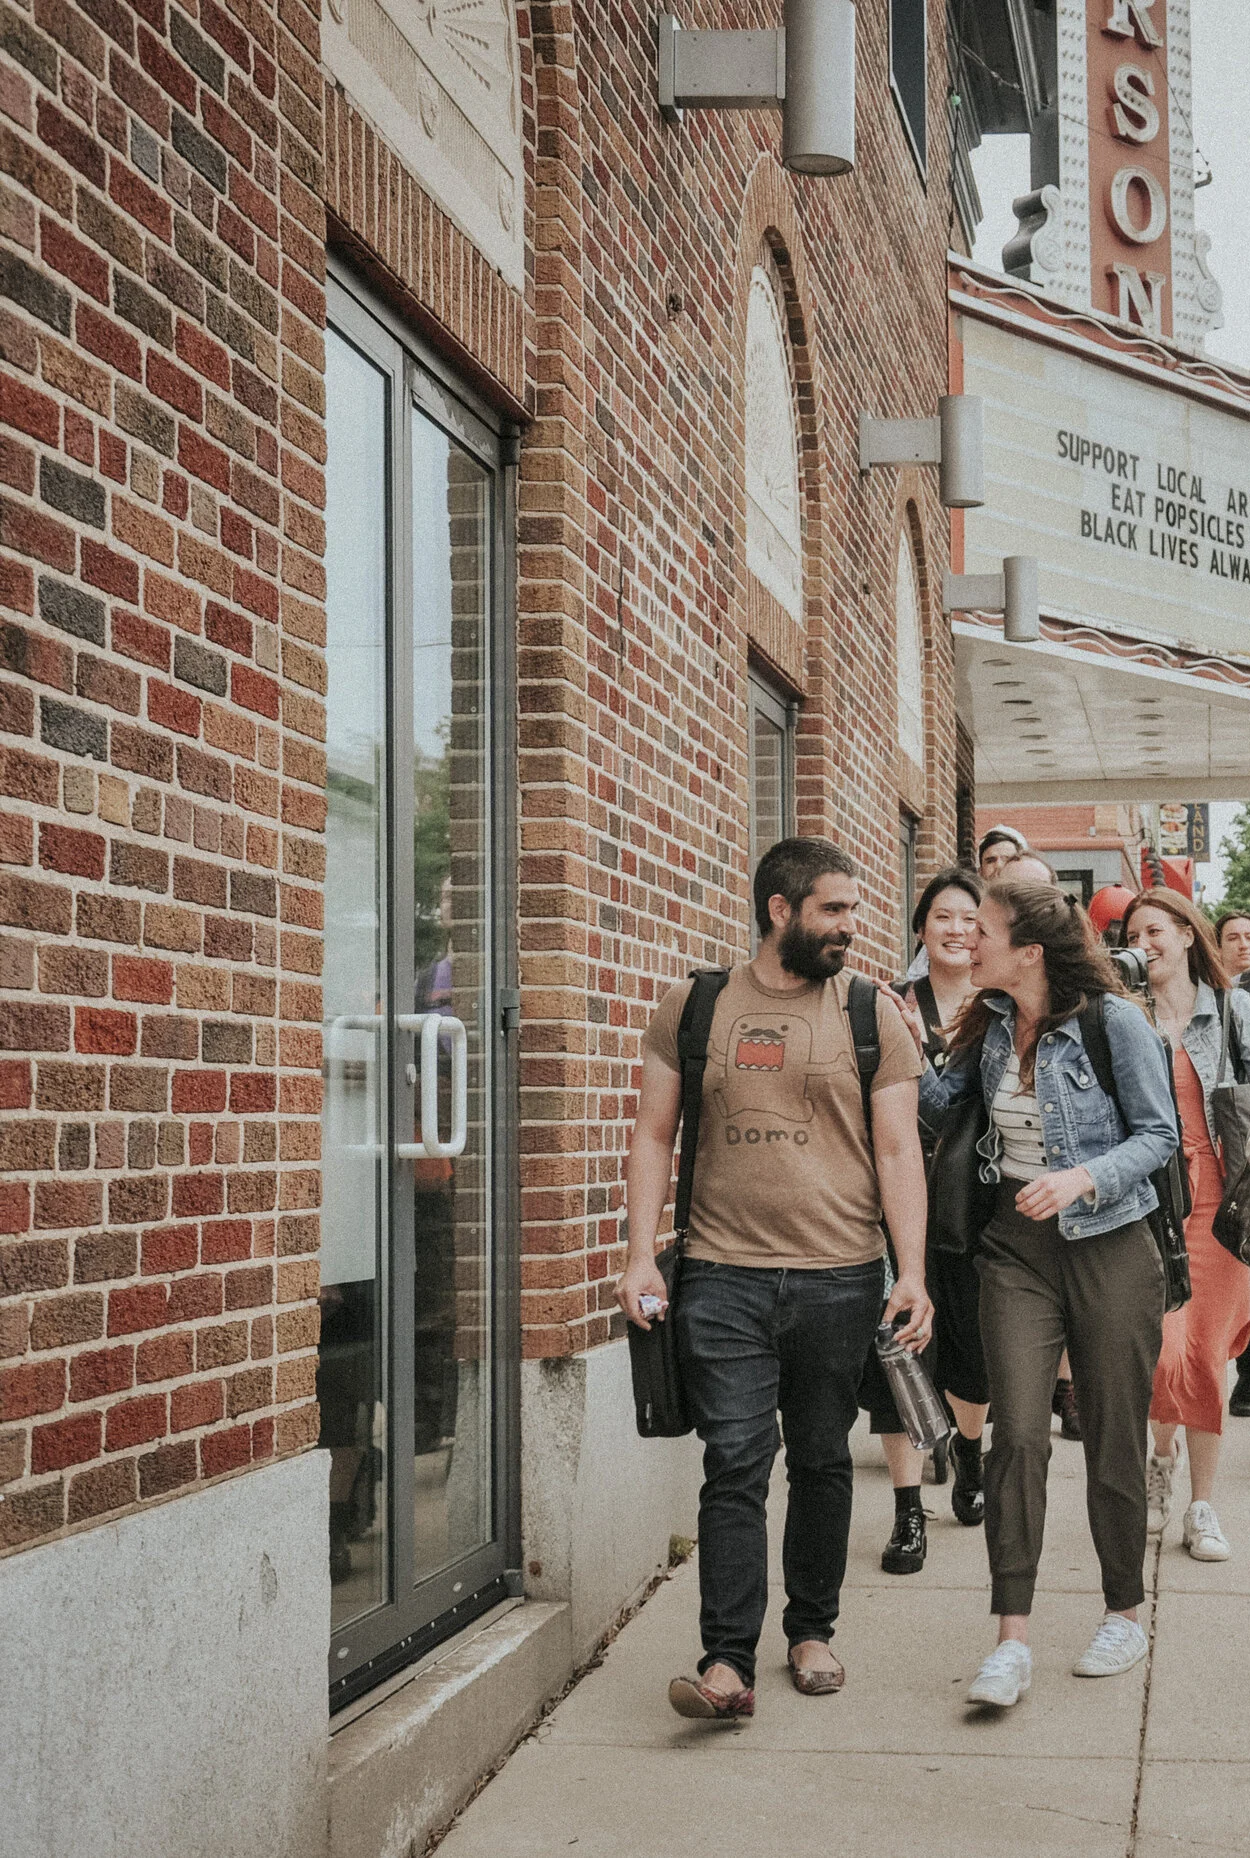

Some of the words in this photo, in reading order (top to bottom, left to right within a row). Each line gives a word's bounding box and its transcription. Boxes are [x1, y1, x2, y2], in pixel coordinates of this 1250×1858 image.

[1056, 429, 1140, 482] SUPPORT
[1157, 462, 1207, 505] LOCAL
[1080, 509, 1138, 551] BLACK
[1150, 528, 1199, 569] LIVES
[1111, 482, 1146, 518] EAT
[1154, 496, 1245, 550] POPSICLES
[725, 1124, 809, 1146] Domo
